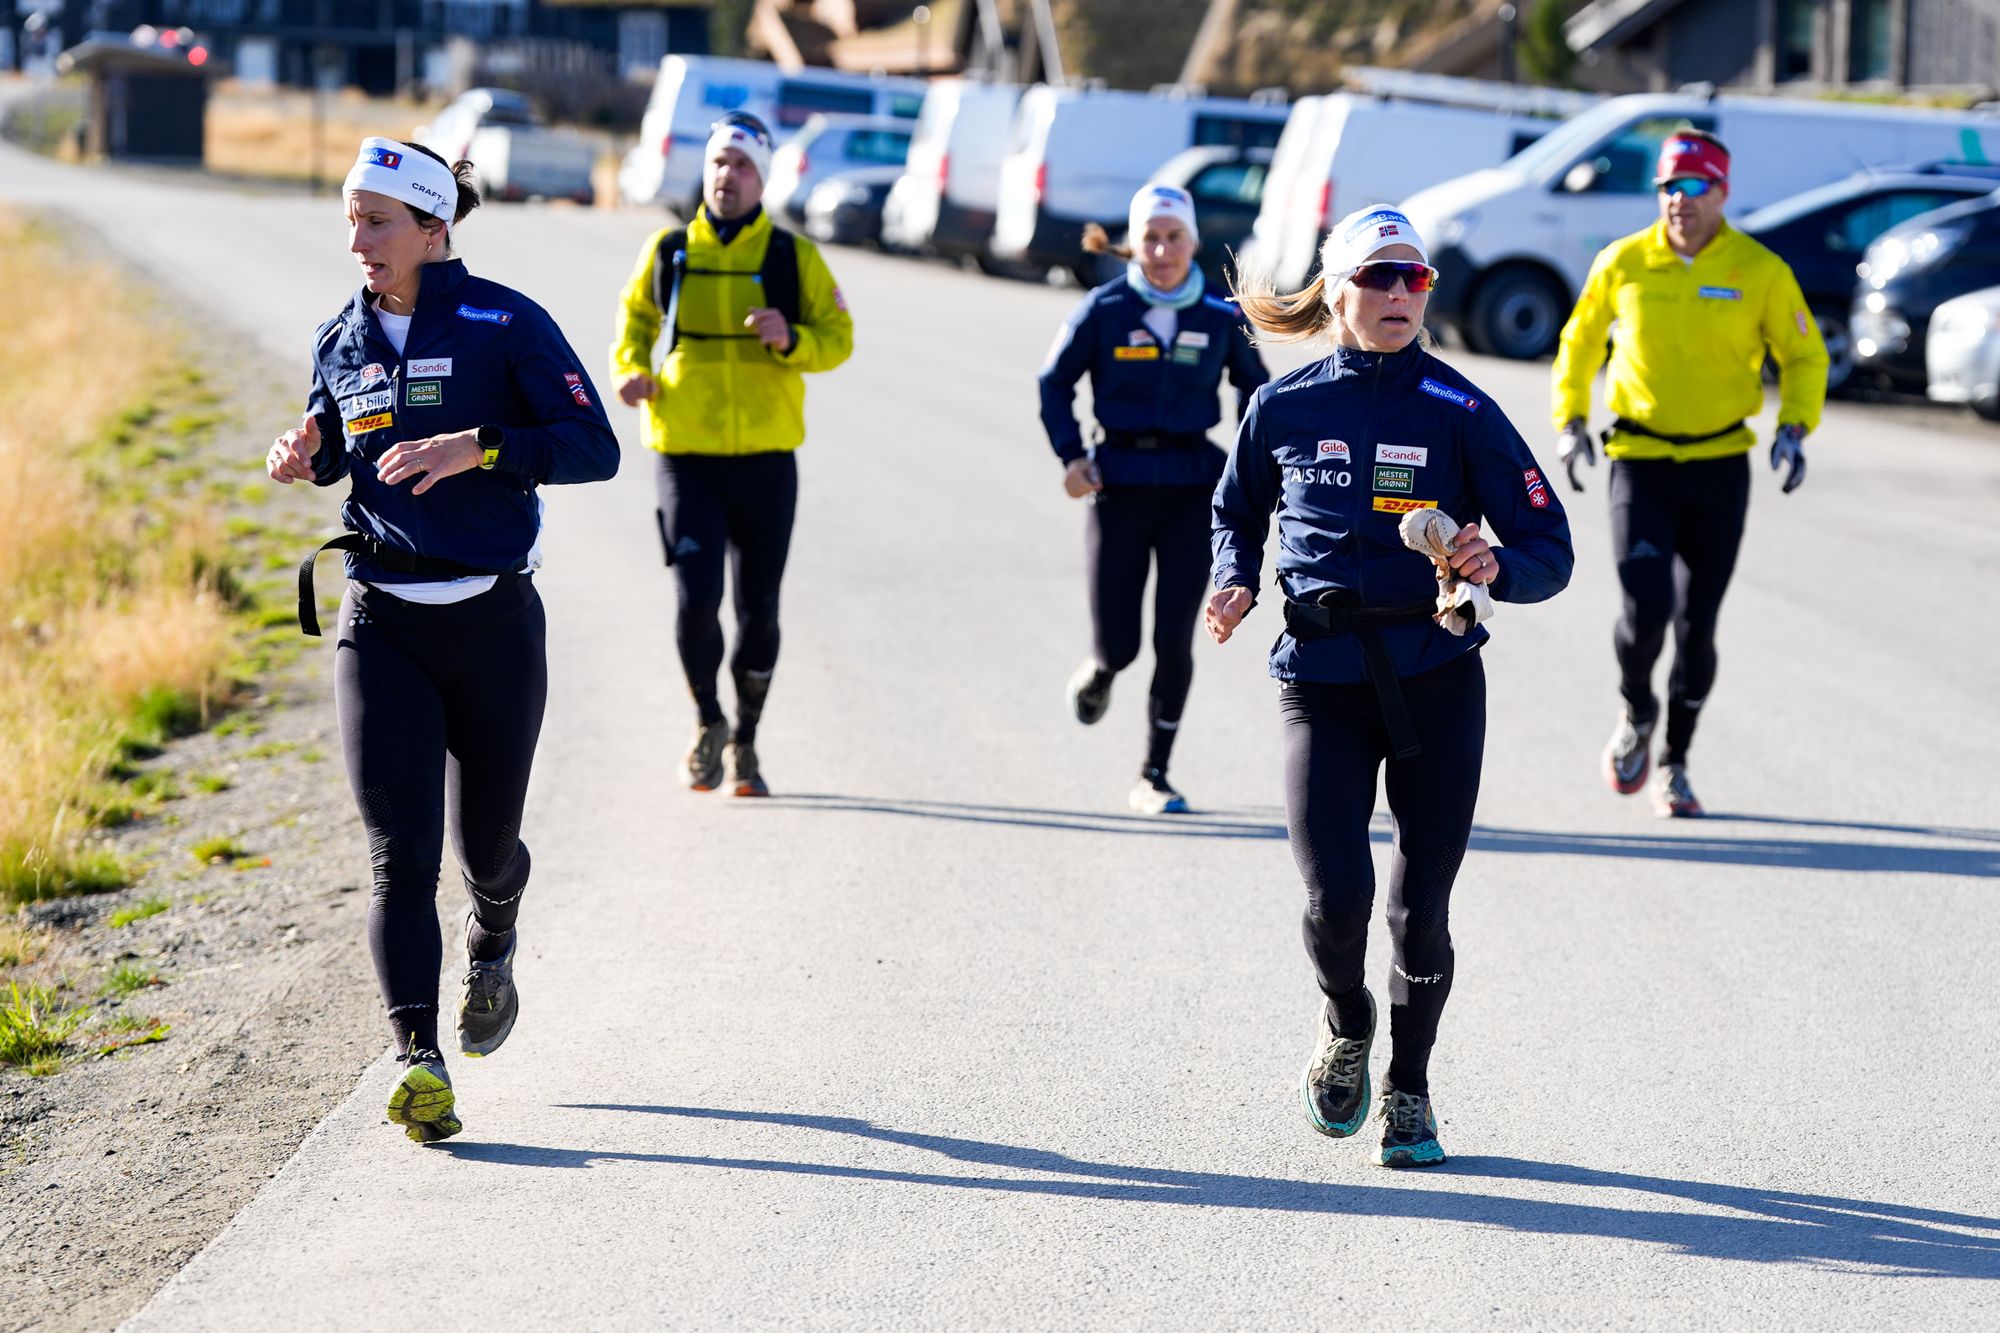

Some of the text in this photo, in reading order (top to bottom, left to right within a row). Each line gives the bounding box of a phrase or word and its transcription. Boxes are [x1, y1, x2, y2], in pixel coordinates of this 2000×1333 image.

[387, 155, 396, 165] 1
[411, 182, 442, 201] CRAFT
[460, 307, 498, 320] SpareBank
[362, 365, 383, 379] Gilde
[412, 363, 447, 373] Scandic
[411, 385, 437, 393] MESTER
[1277, 382, 1306, 393] CRAFT
[411, 394, 437, 402] GRØNN
[1422, 380, 1475, 407] SpareBank 1
[353, 416, 385, 431] DHL
[1320, 442, 1348, 453] Gilde
[1381, 449, 1422, 462] Scandic
[1378, 470, 1409, 479] MESTER
[1378, 479, 1407, 488] GRØNN
